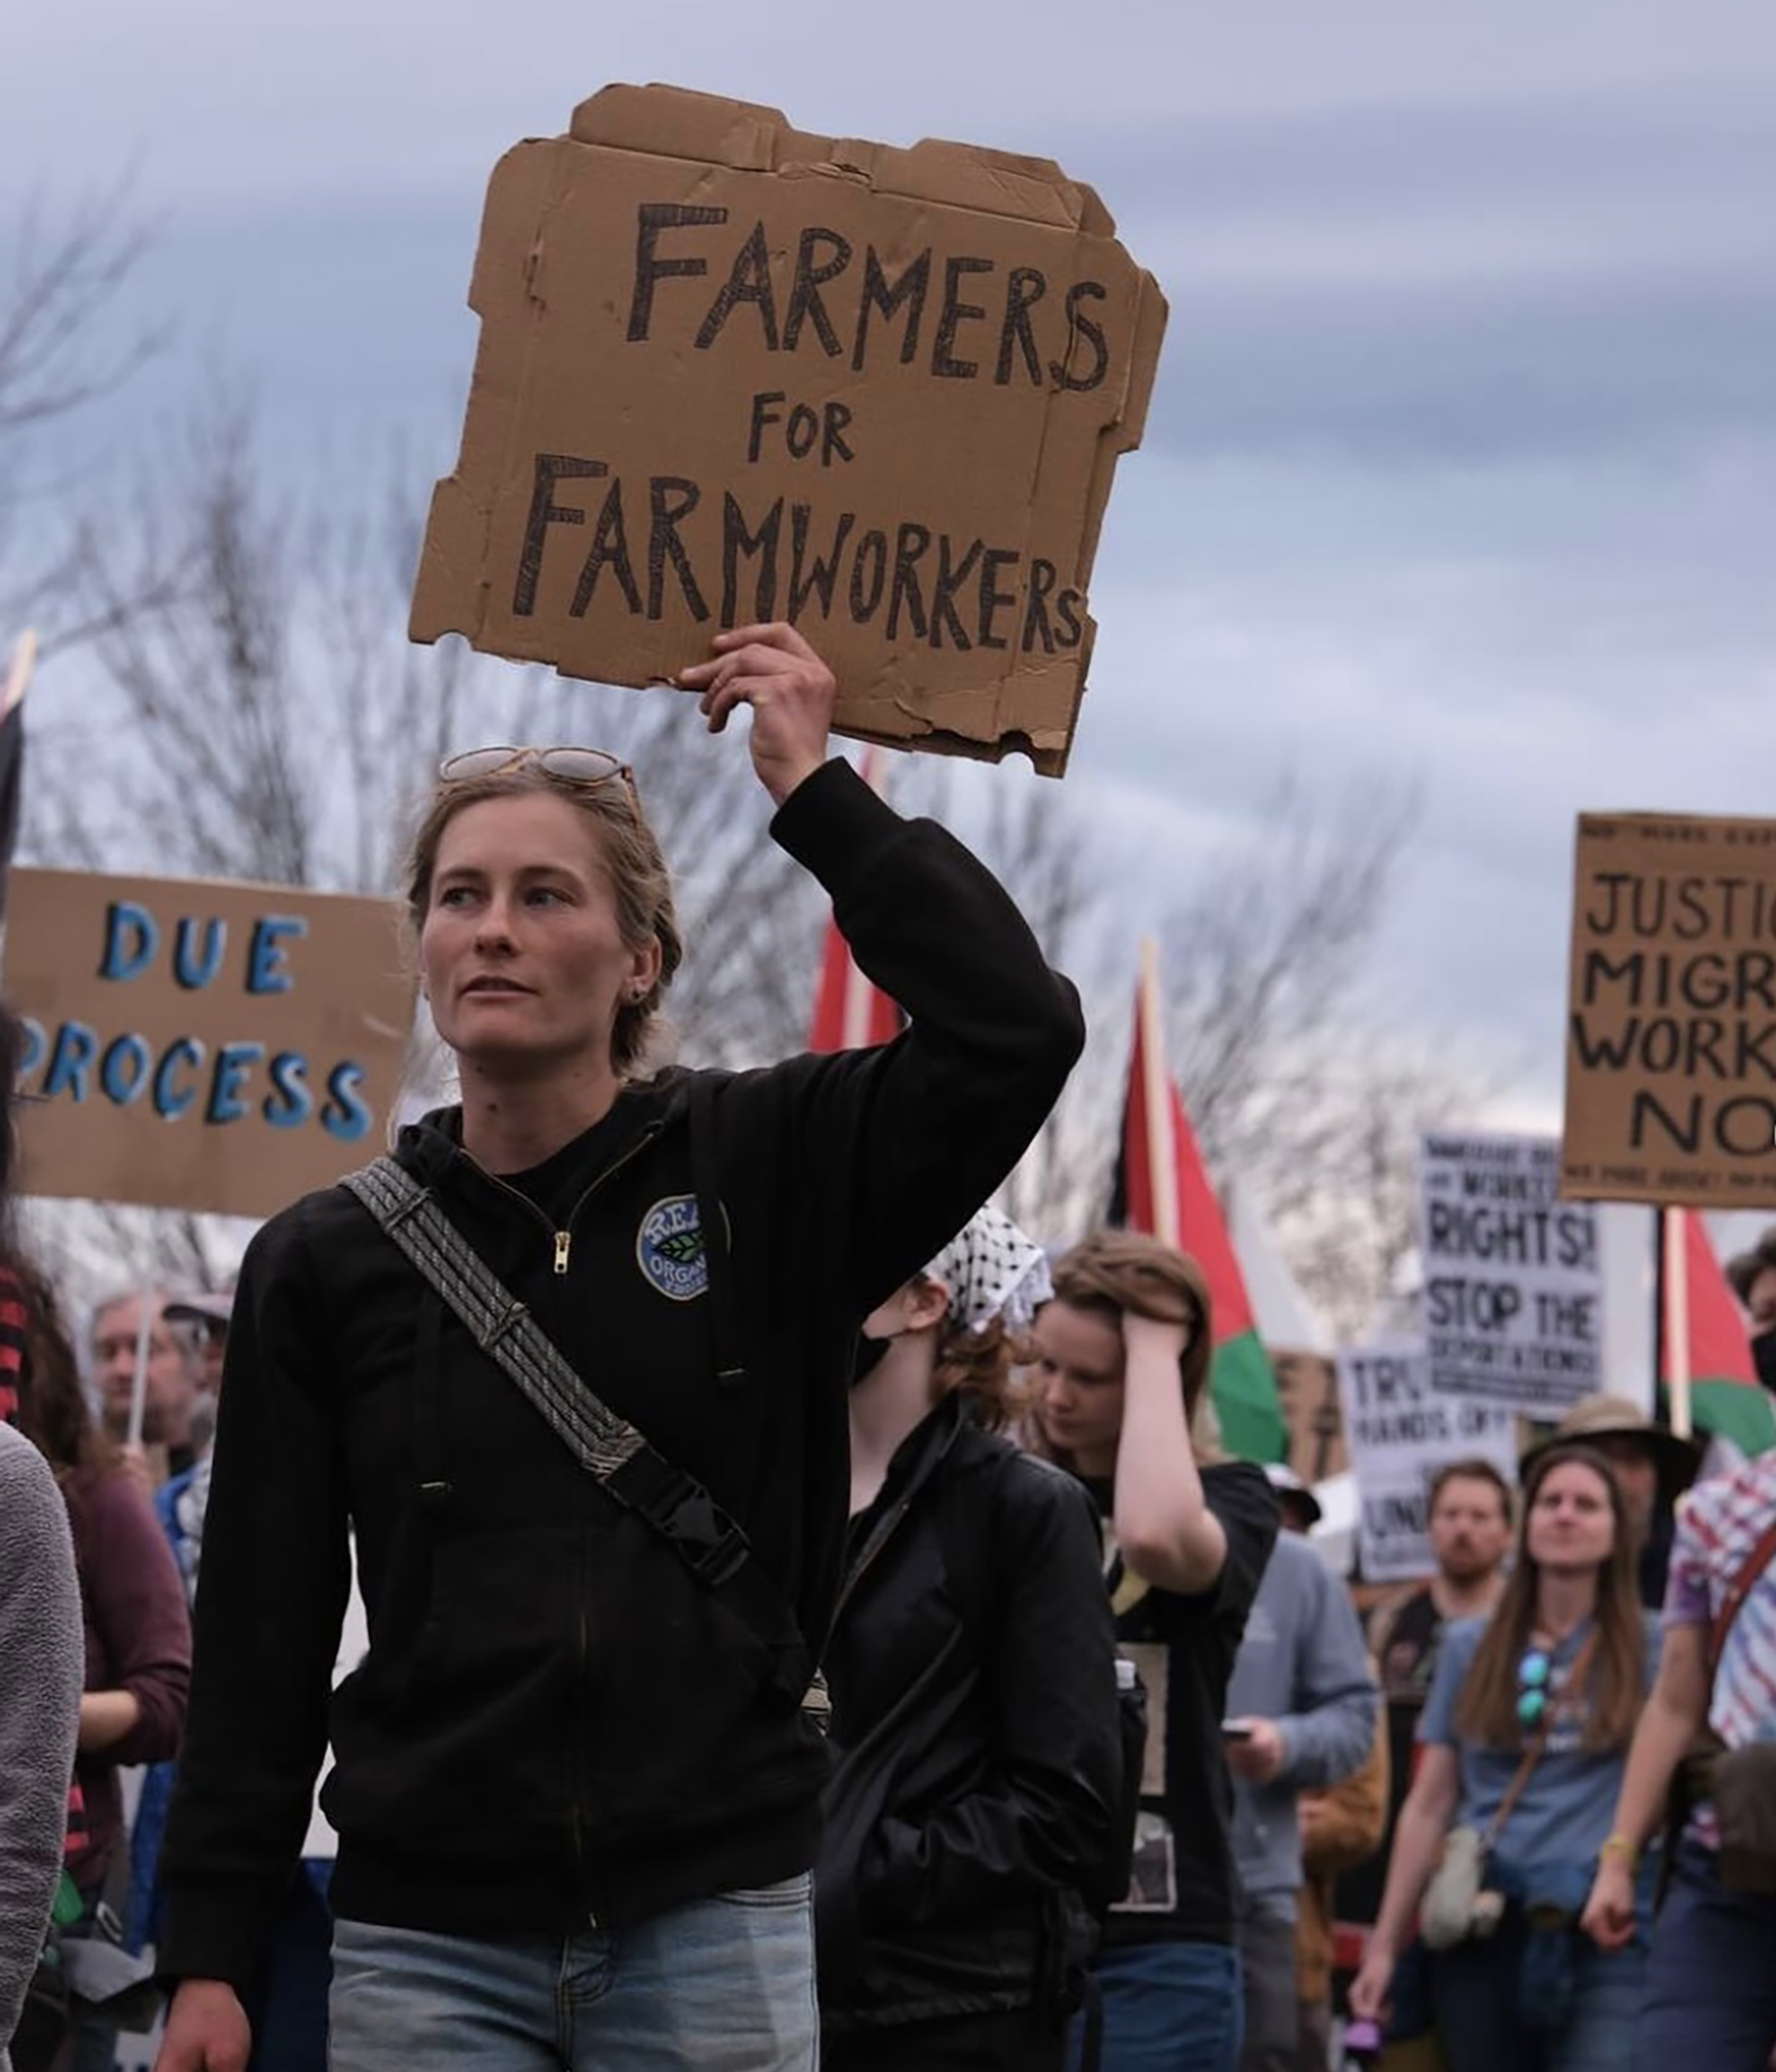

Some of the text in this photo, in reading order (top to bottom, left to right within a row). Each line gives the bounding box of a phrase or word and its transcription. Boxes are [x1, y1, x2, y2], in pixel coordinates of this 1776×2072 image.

[626, 203, 1110, 392] FARMERS
[748, 392, 855, 467] FOR
[512, 454, 1083, 653] FARMWORKERS
[1587, 872, 1776, 940] JUSTI
[99, 901, 309, 996] DUE
[1583, 947, 1776, 1010] MIGR
[1571, 1012, 1776, 1080] WORK
[1629, 1088, 1776, 1157] NO
[644, 1203, 700, 1245] RE
[1428, 1201, 1597, 1272] RIGHTS!
[1428, 1277, 1596, 1342] STOP THE
